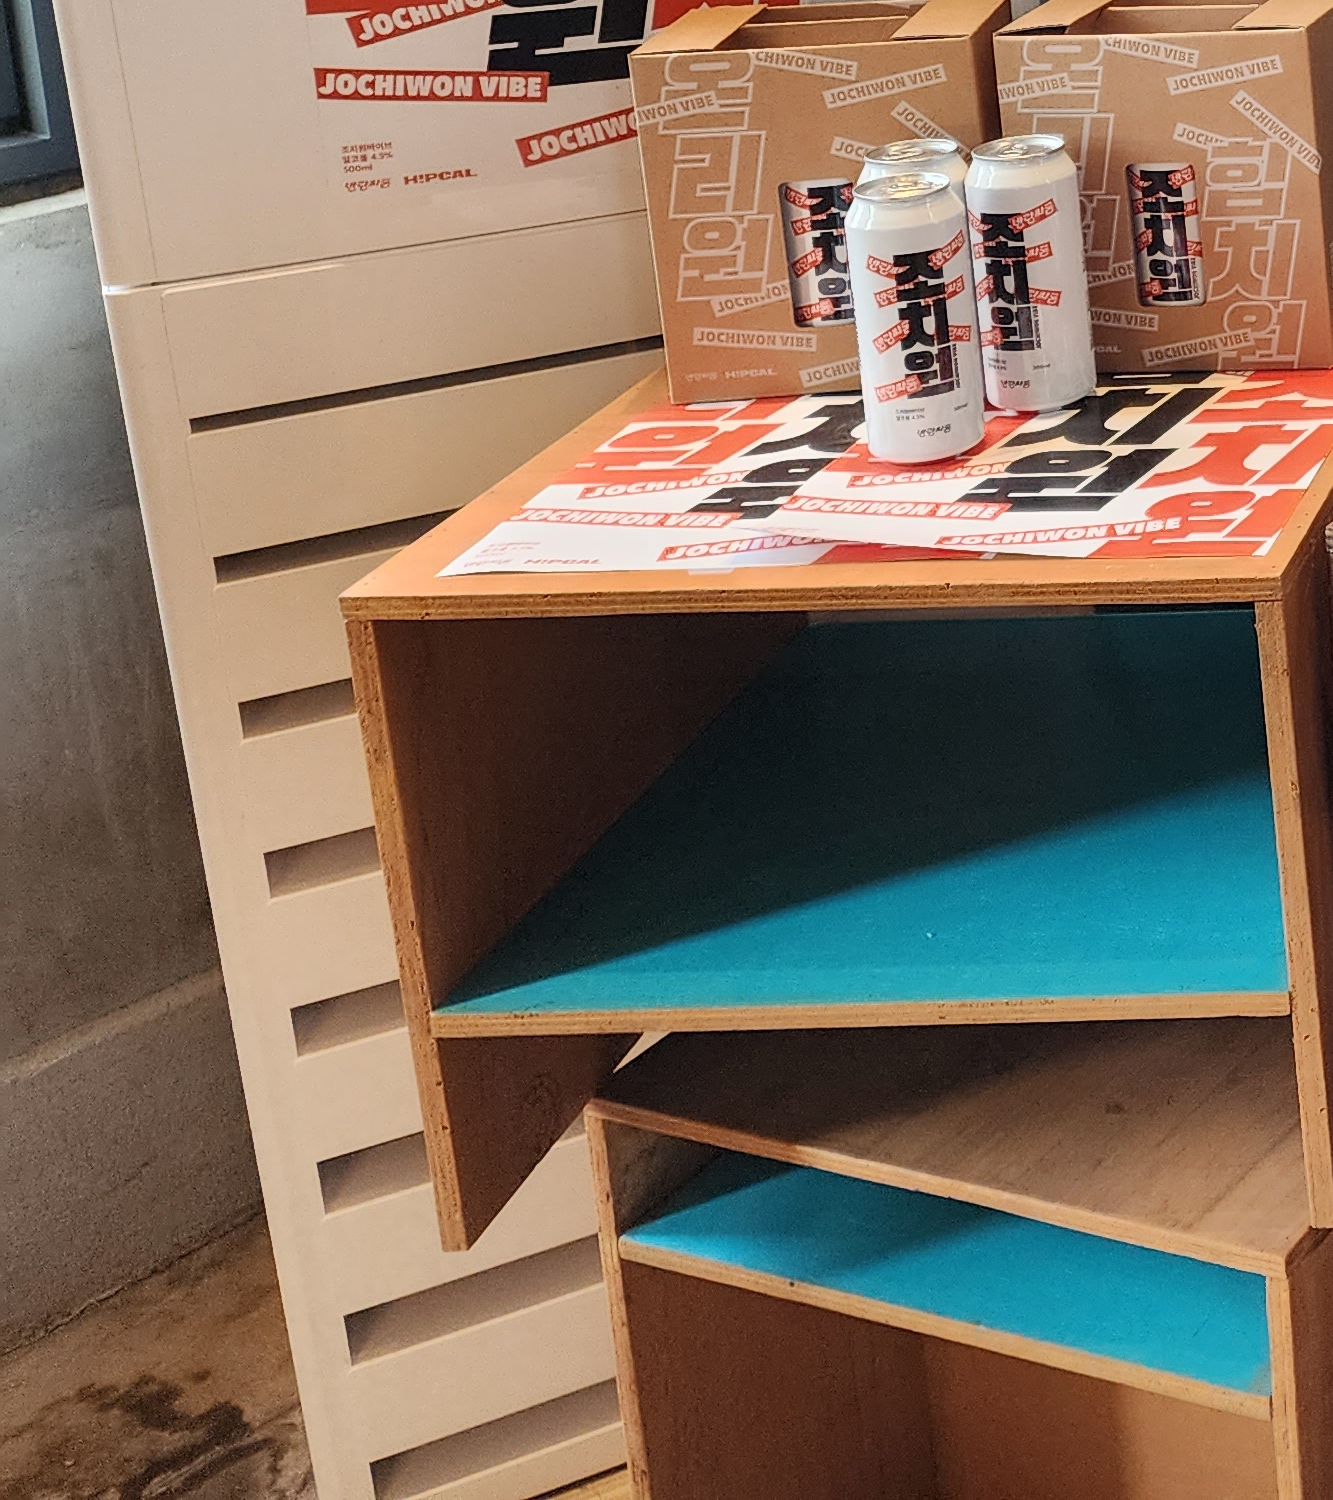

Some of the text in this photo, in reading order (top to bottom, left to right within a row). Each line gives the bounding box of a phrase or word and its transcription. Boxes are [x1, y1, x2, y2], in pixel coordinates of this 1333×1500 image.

[752, 50, 854, 76] CHIWON VIBE
[1104, 36, 1196, 64] CHIWON VIBE
[318, 73, 542, 99] JOCHIWON VIBE
[828, 67, 943, 105] JOCHIWON VIBE
[999, 76, 1068, 100] IWON VIBE
[1172, 59, 1279, 91] JOCHIWON VIBE
[637, 94, 715, 123] IWON VIBE
[1235, 96, 1299, 149] JOCHIWON
[526, 109, 638, 162] JOCHIW
[896, 106, 948, 140] JOCHI
[892, 247, 955, 400] 조치원
[1125, 313, 1156, 328] VIBE
[696, 331, 814, 349] JOCHIWON VIBE
[1146, 332, 1251, 362] JOCHIWON VIBE
[805, 363, 861, 383] JOCHIW
[584, 469, 749, 498] JOCHIWON
[853, 461, 1010, 486] JOCHIWON
[509, 508, 733, 528] JOCHIWON VIBE
[784, 497, 998, 520] JOCHIWON VIBE
[943, 516, 1183, 547] JOCHIWON VIBE
[666, 535, 824, 559] JOCHIW
